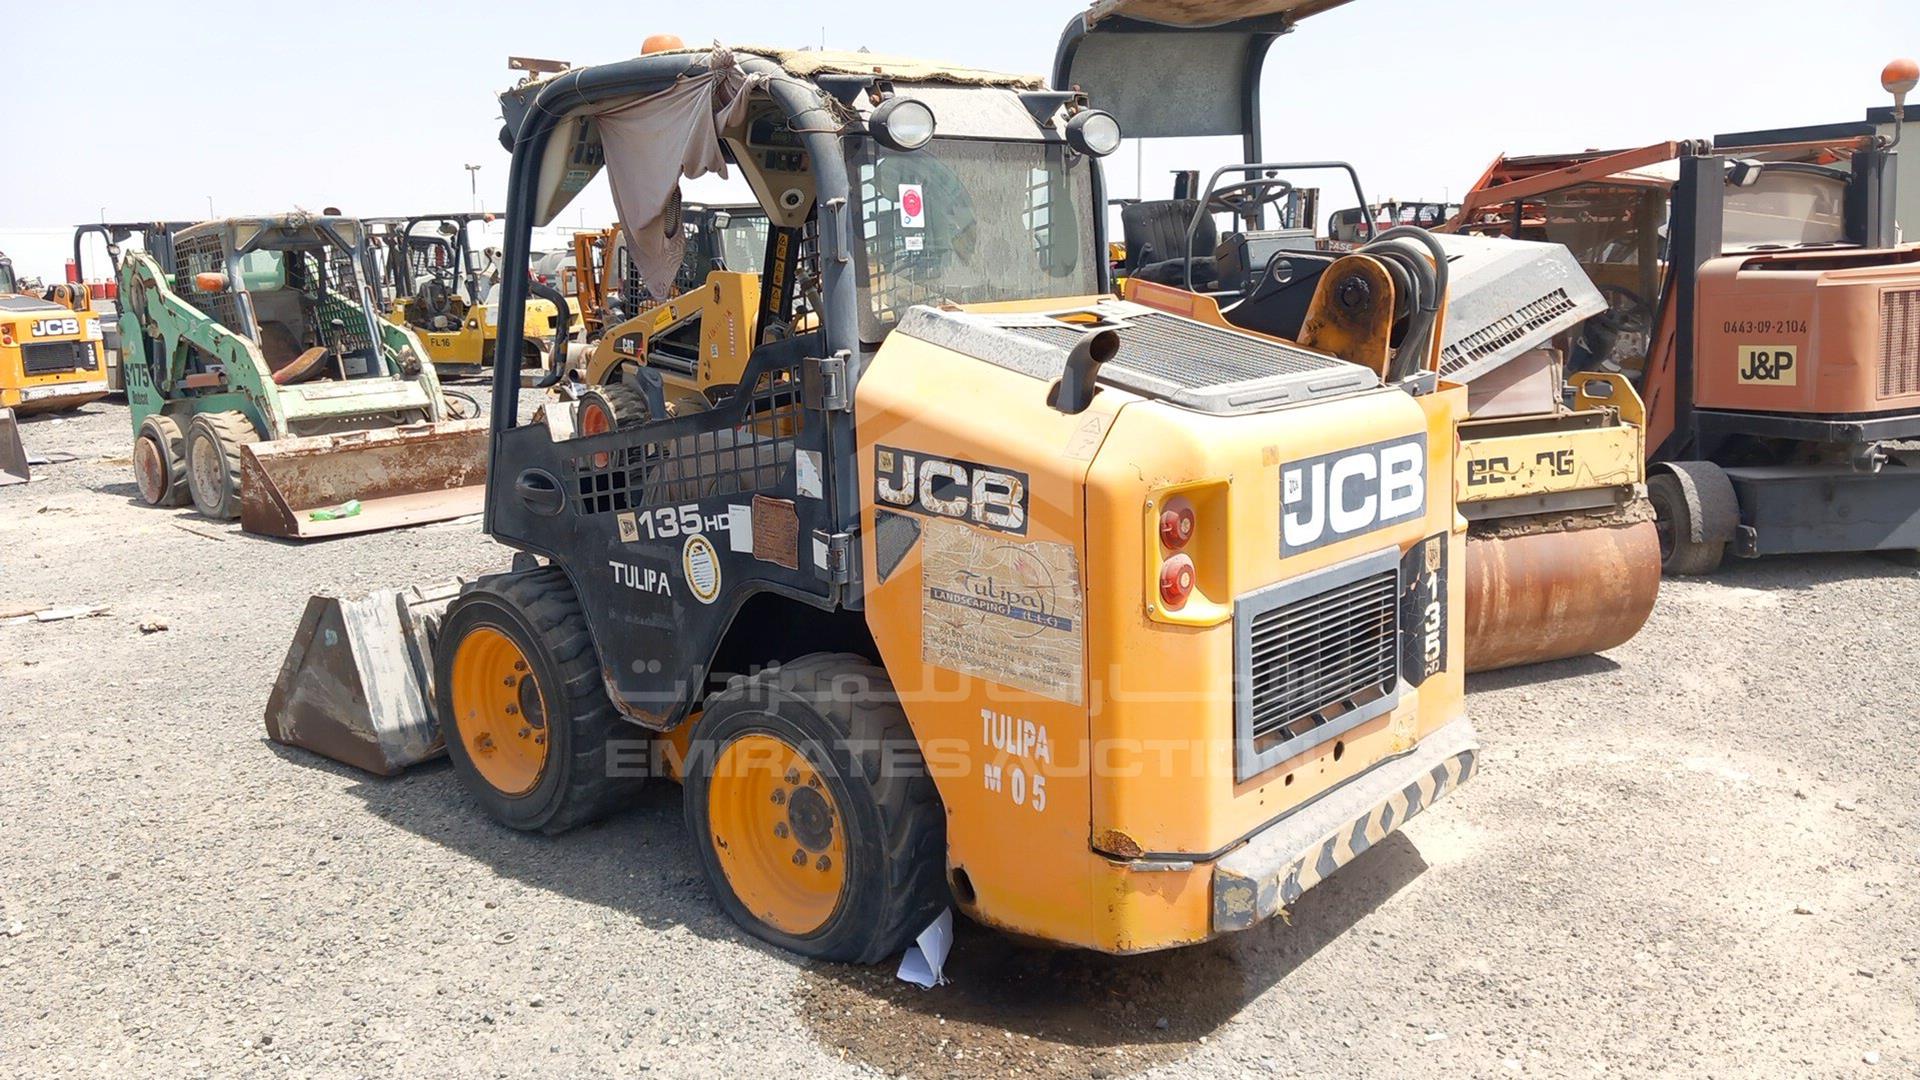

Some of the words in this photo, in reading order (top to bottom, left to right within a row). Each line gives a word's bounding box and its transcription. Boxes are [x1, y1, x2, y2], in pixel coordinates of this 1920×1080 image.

[32, 319, 79, 336] JCB
[1723, 320, 1807, 334] 0443-09-2104
[1741, 351, 1794, 380] J&P
[877, 454, 1025, 529] JCB
[1283, 441, 1425, 547] JCB
[638, 503, 703, 540] 135
[608, 560, 673, 597] TULIPA
[955, 569, 1039, 608] Tulipa
[933, 588, 1008, 615] LANDSCAPING
[981, 708, 1051, 765] TULIPA
